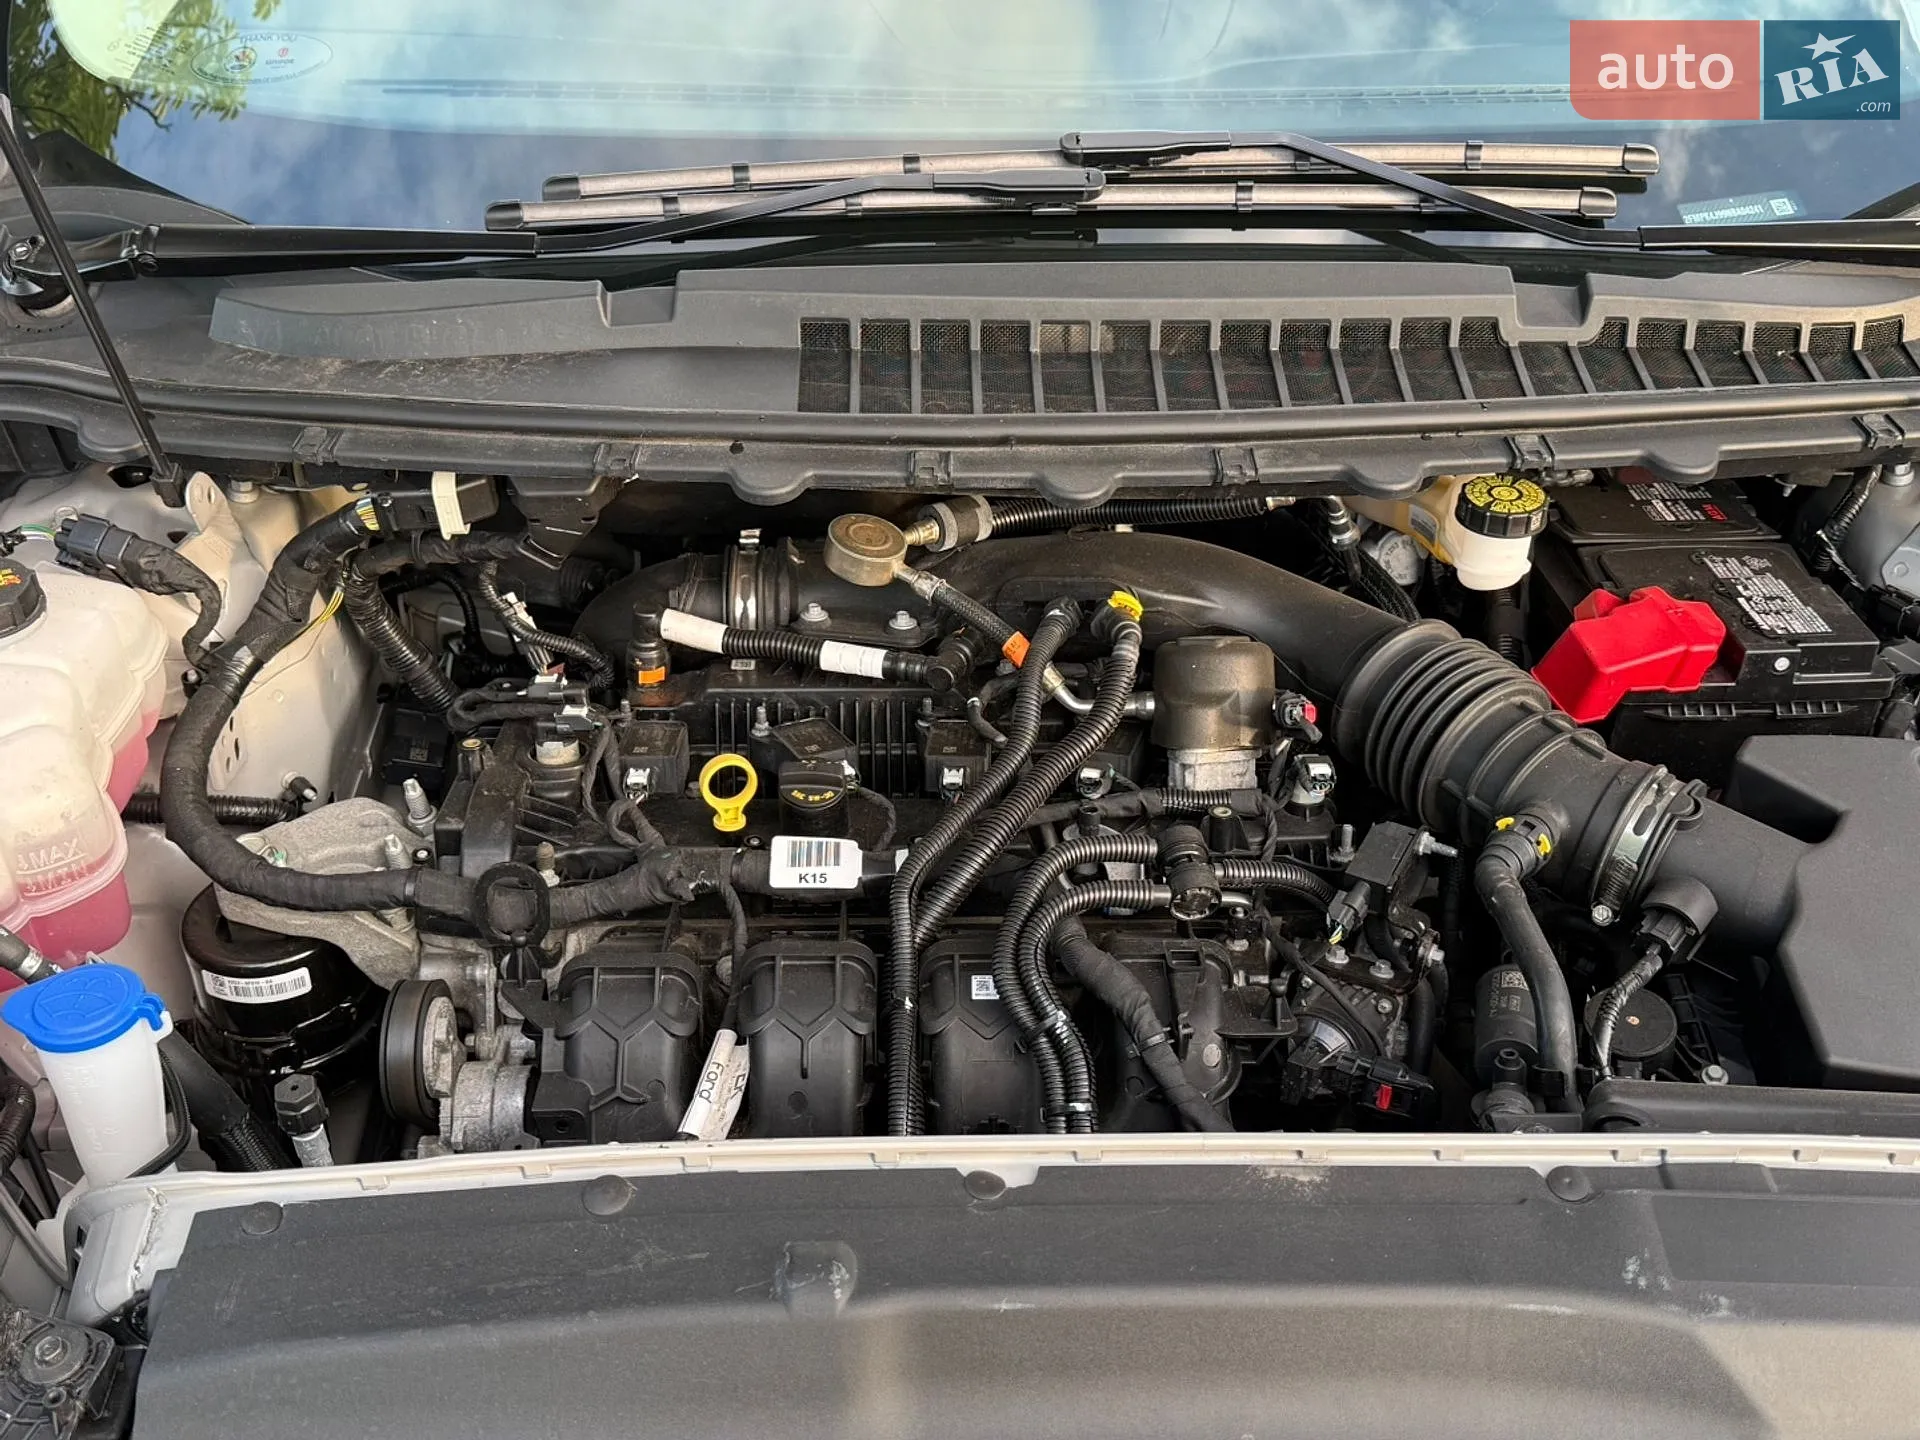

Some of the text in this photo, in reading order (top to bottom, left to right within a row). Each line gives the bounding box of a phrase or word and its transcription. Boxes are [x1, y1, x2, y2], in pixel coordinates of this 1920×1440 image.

[28, 838, 82, 870] MAX
[36, 861, 89, 891] MIN
[798, 873, 828, 884] K15
